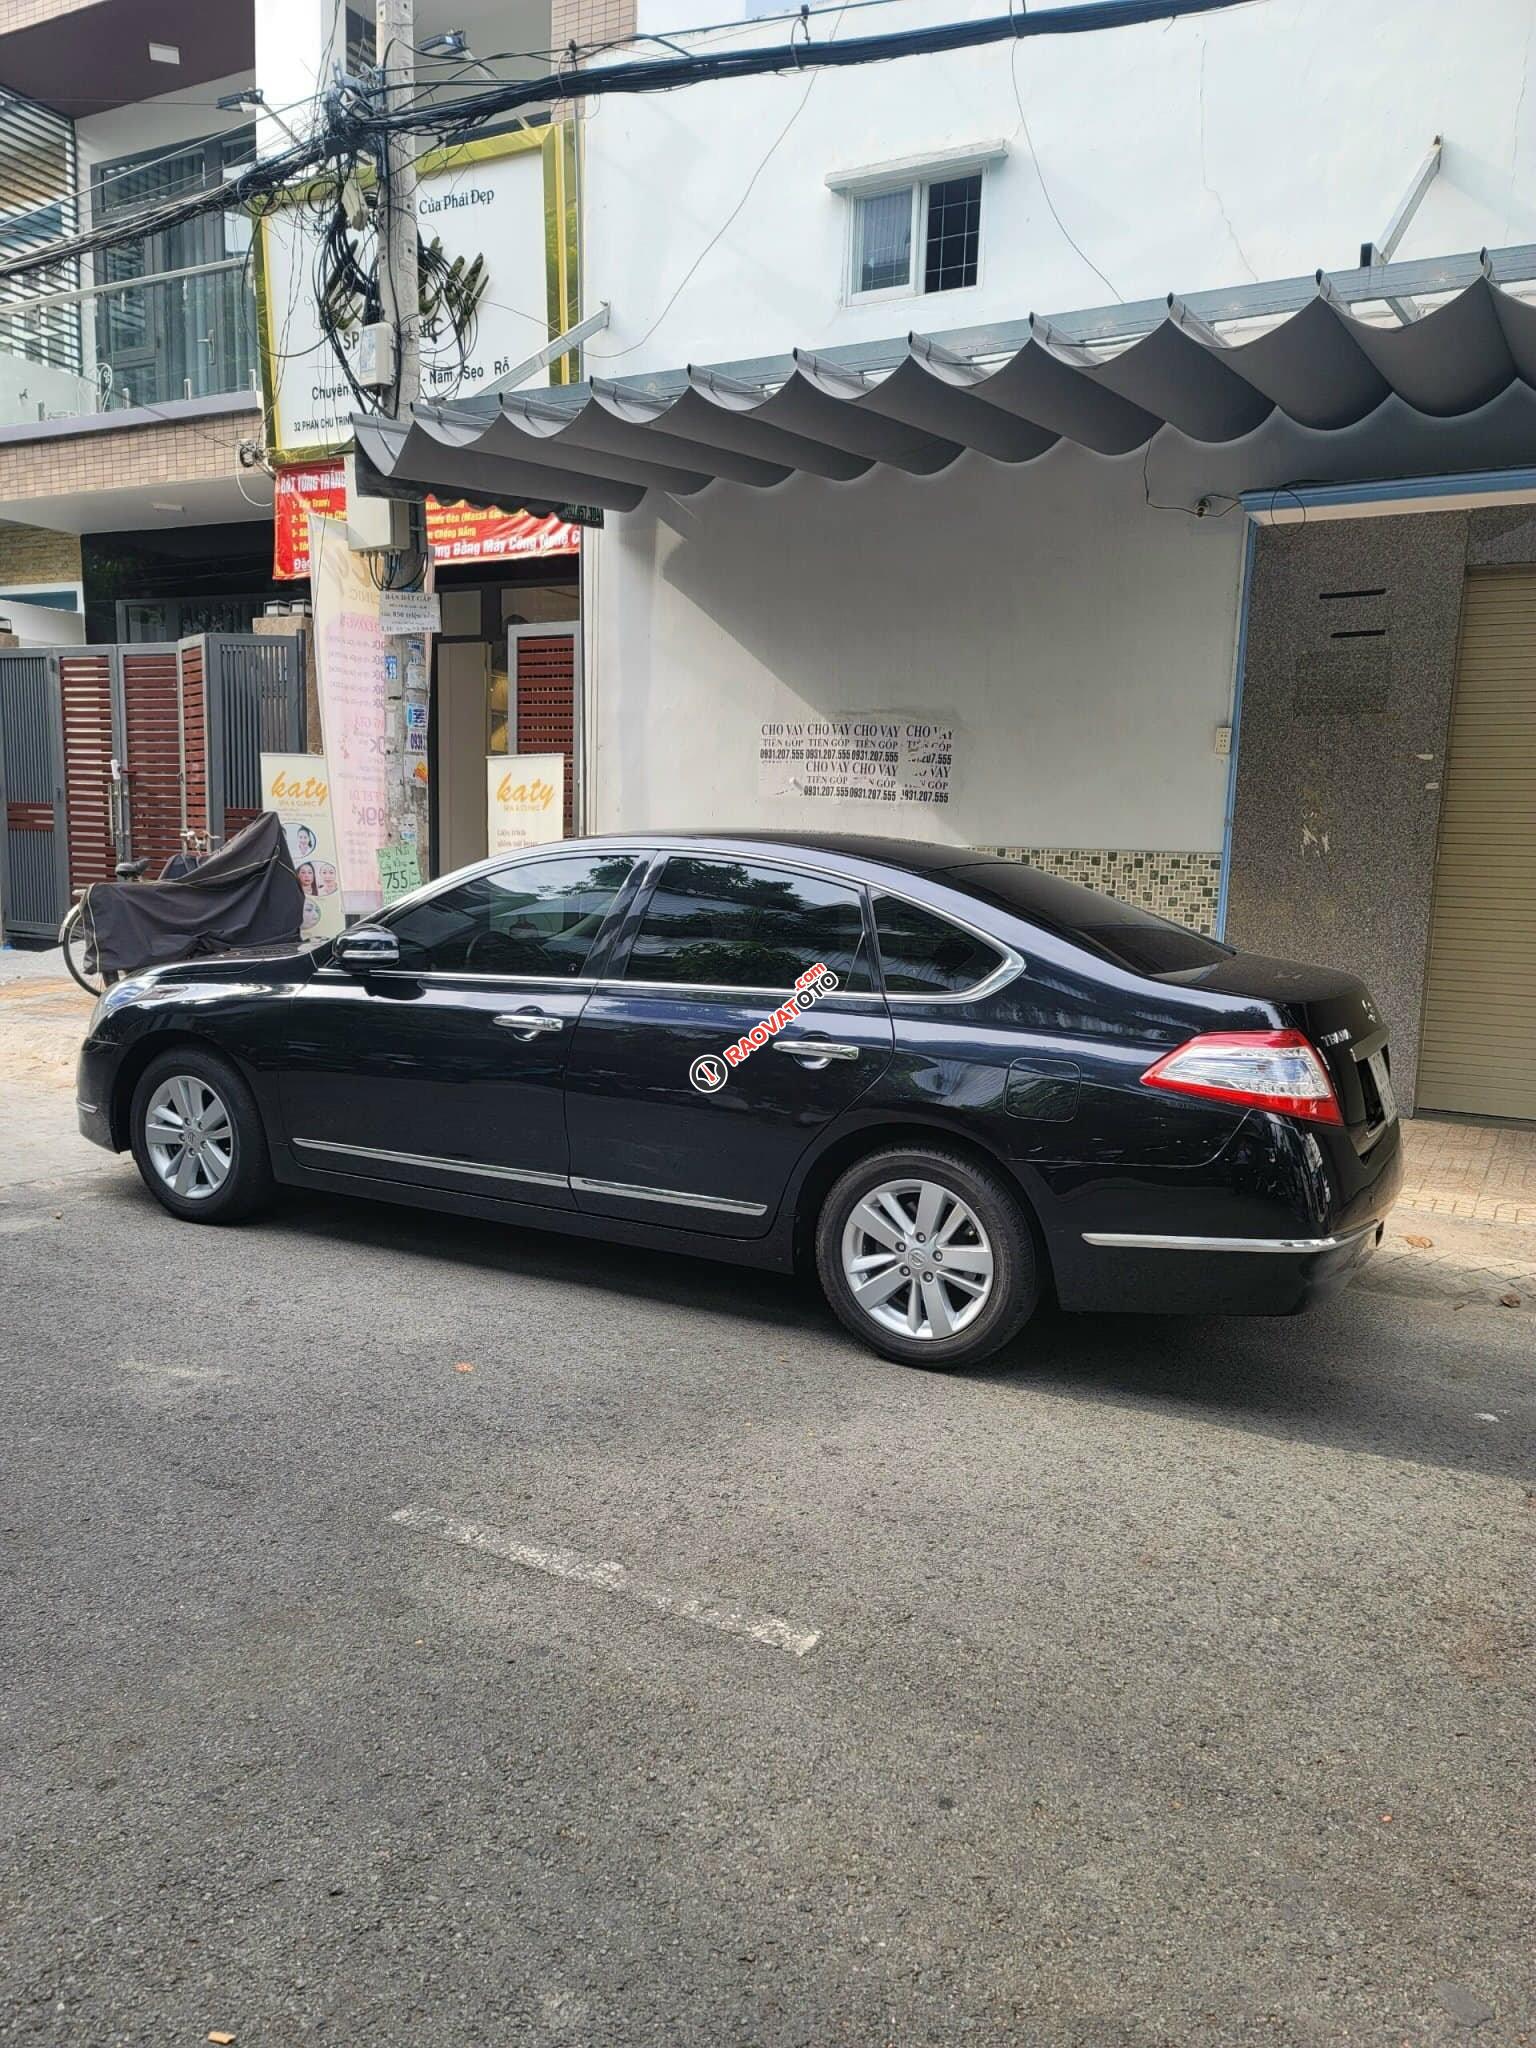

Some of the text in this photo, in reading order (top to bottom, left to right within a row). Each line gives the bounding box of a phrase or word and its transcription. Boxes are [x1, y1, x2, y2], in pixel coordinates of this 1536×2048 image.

[443, 192, 469, 210] Phái
[343, 331, 360, 350] SP
[761, 724, 803, 736] CHO VAY
[807, 723, 850, 736] CHO VAY
[853, 724, 900, 738] CHO VAY
[906, 725, 931, 738] CHO
[760, 748, 804, 760] 0931.207.555
[805, 748, 851, 760] 0931.207.555
[852, 750, 898, 763] 0931.207.555
[805, 760, 850, 773] CHO VAY
[852, 762, 876, 775] CHO
[878, 763, 898, 777] VAY
[271, 771, 328, 807] katy
[496, 771, 554, 811] katy
[803, 785, 849, 797] 0931.207.555
[383, 870, 408, 889] 755
